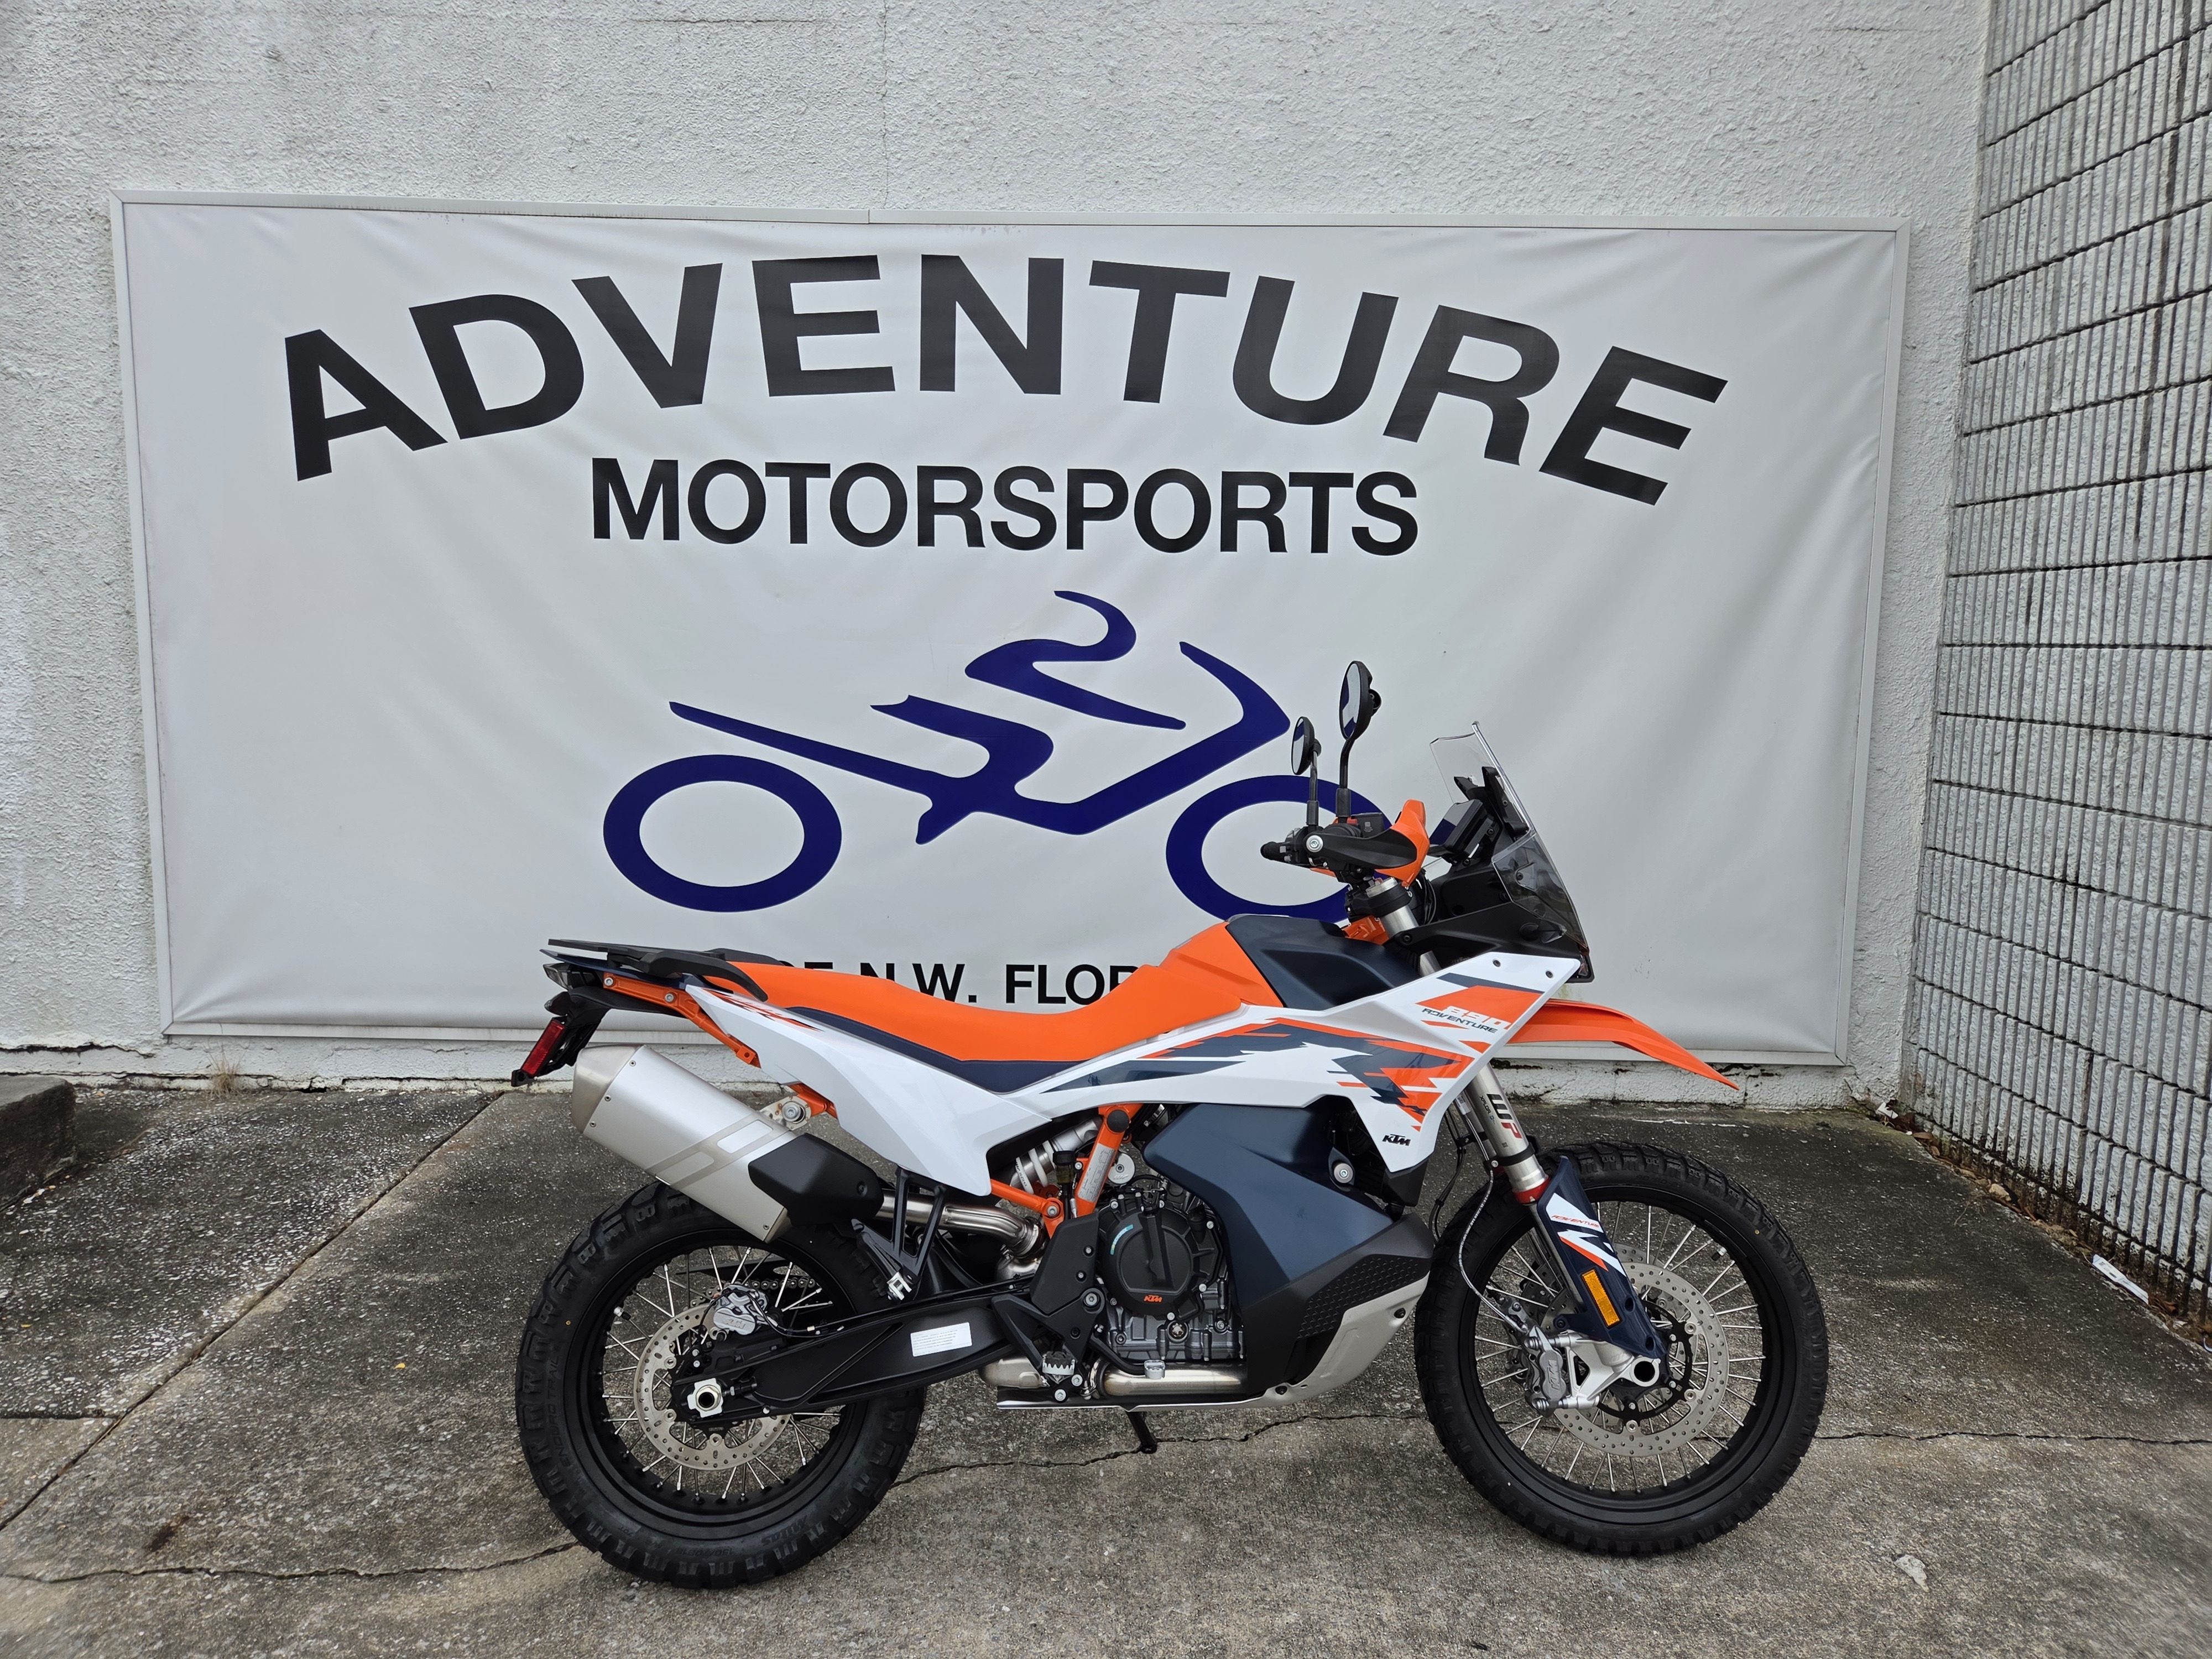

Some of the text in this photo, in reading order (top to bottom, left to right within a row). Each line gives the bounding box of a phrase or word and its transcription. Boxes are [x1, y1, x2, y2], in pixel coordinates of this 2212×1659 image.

[285, 254, 1728, 505] ADVENTURE
[592, 458, 1417, 556] MOTORSPORTS
[1422, 1008, 1498, 1034] ADVENTURE
[1442, 1005, 1512, 1030] 890
[1486, 1093, 1522, 1139] WP
[1382, 1134, 1411, 1146] KTM
[1551, 1215, 1600, 1228] ADVENTURE
[1144, 1295, 1162, 1303] KTM
[1546, 1359, 1561, 1391] KTM
[546, 1355, 571, 1468] ENDURO TRAIL
